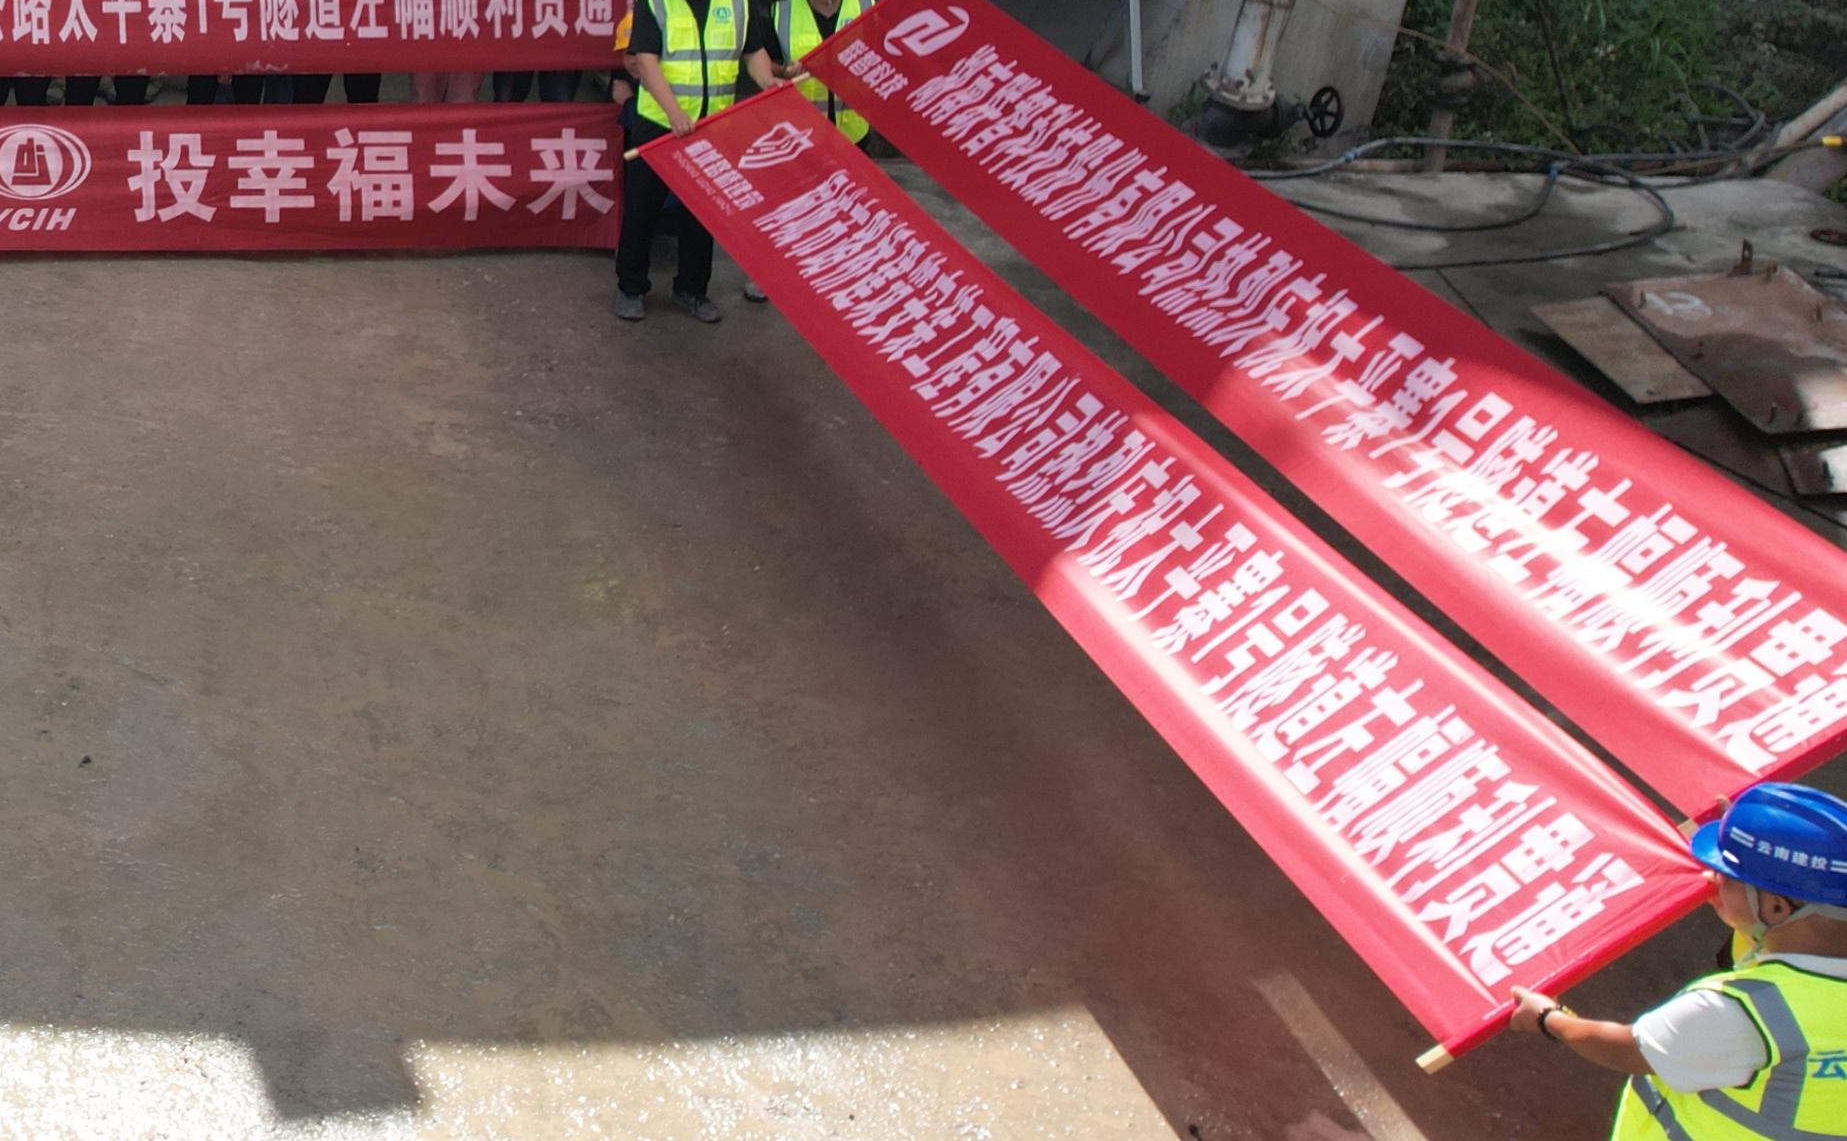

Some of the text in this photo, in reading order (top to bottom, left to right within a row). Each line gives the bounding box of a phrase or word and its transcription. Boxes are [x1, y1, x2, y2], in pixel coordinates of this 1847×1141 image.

[837, 38, 909, 101] 联智科技
[127, 127, 616, 223] 投幸福未来
[1757, 840, 1828, 871] 云南建投
